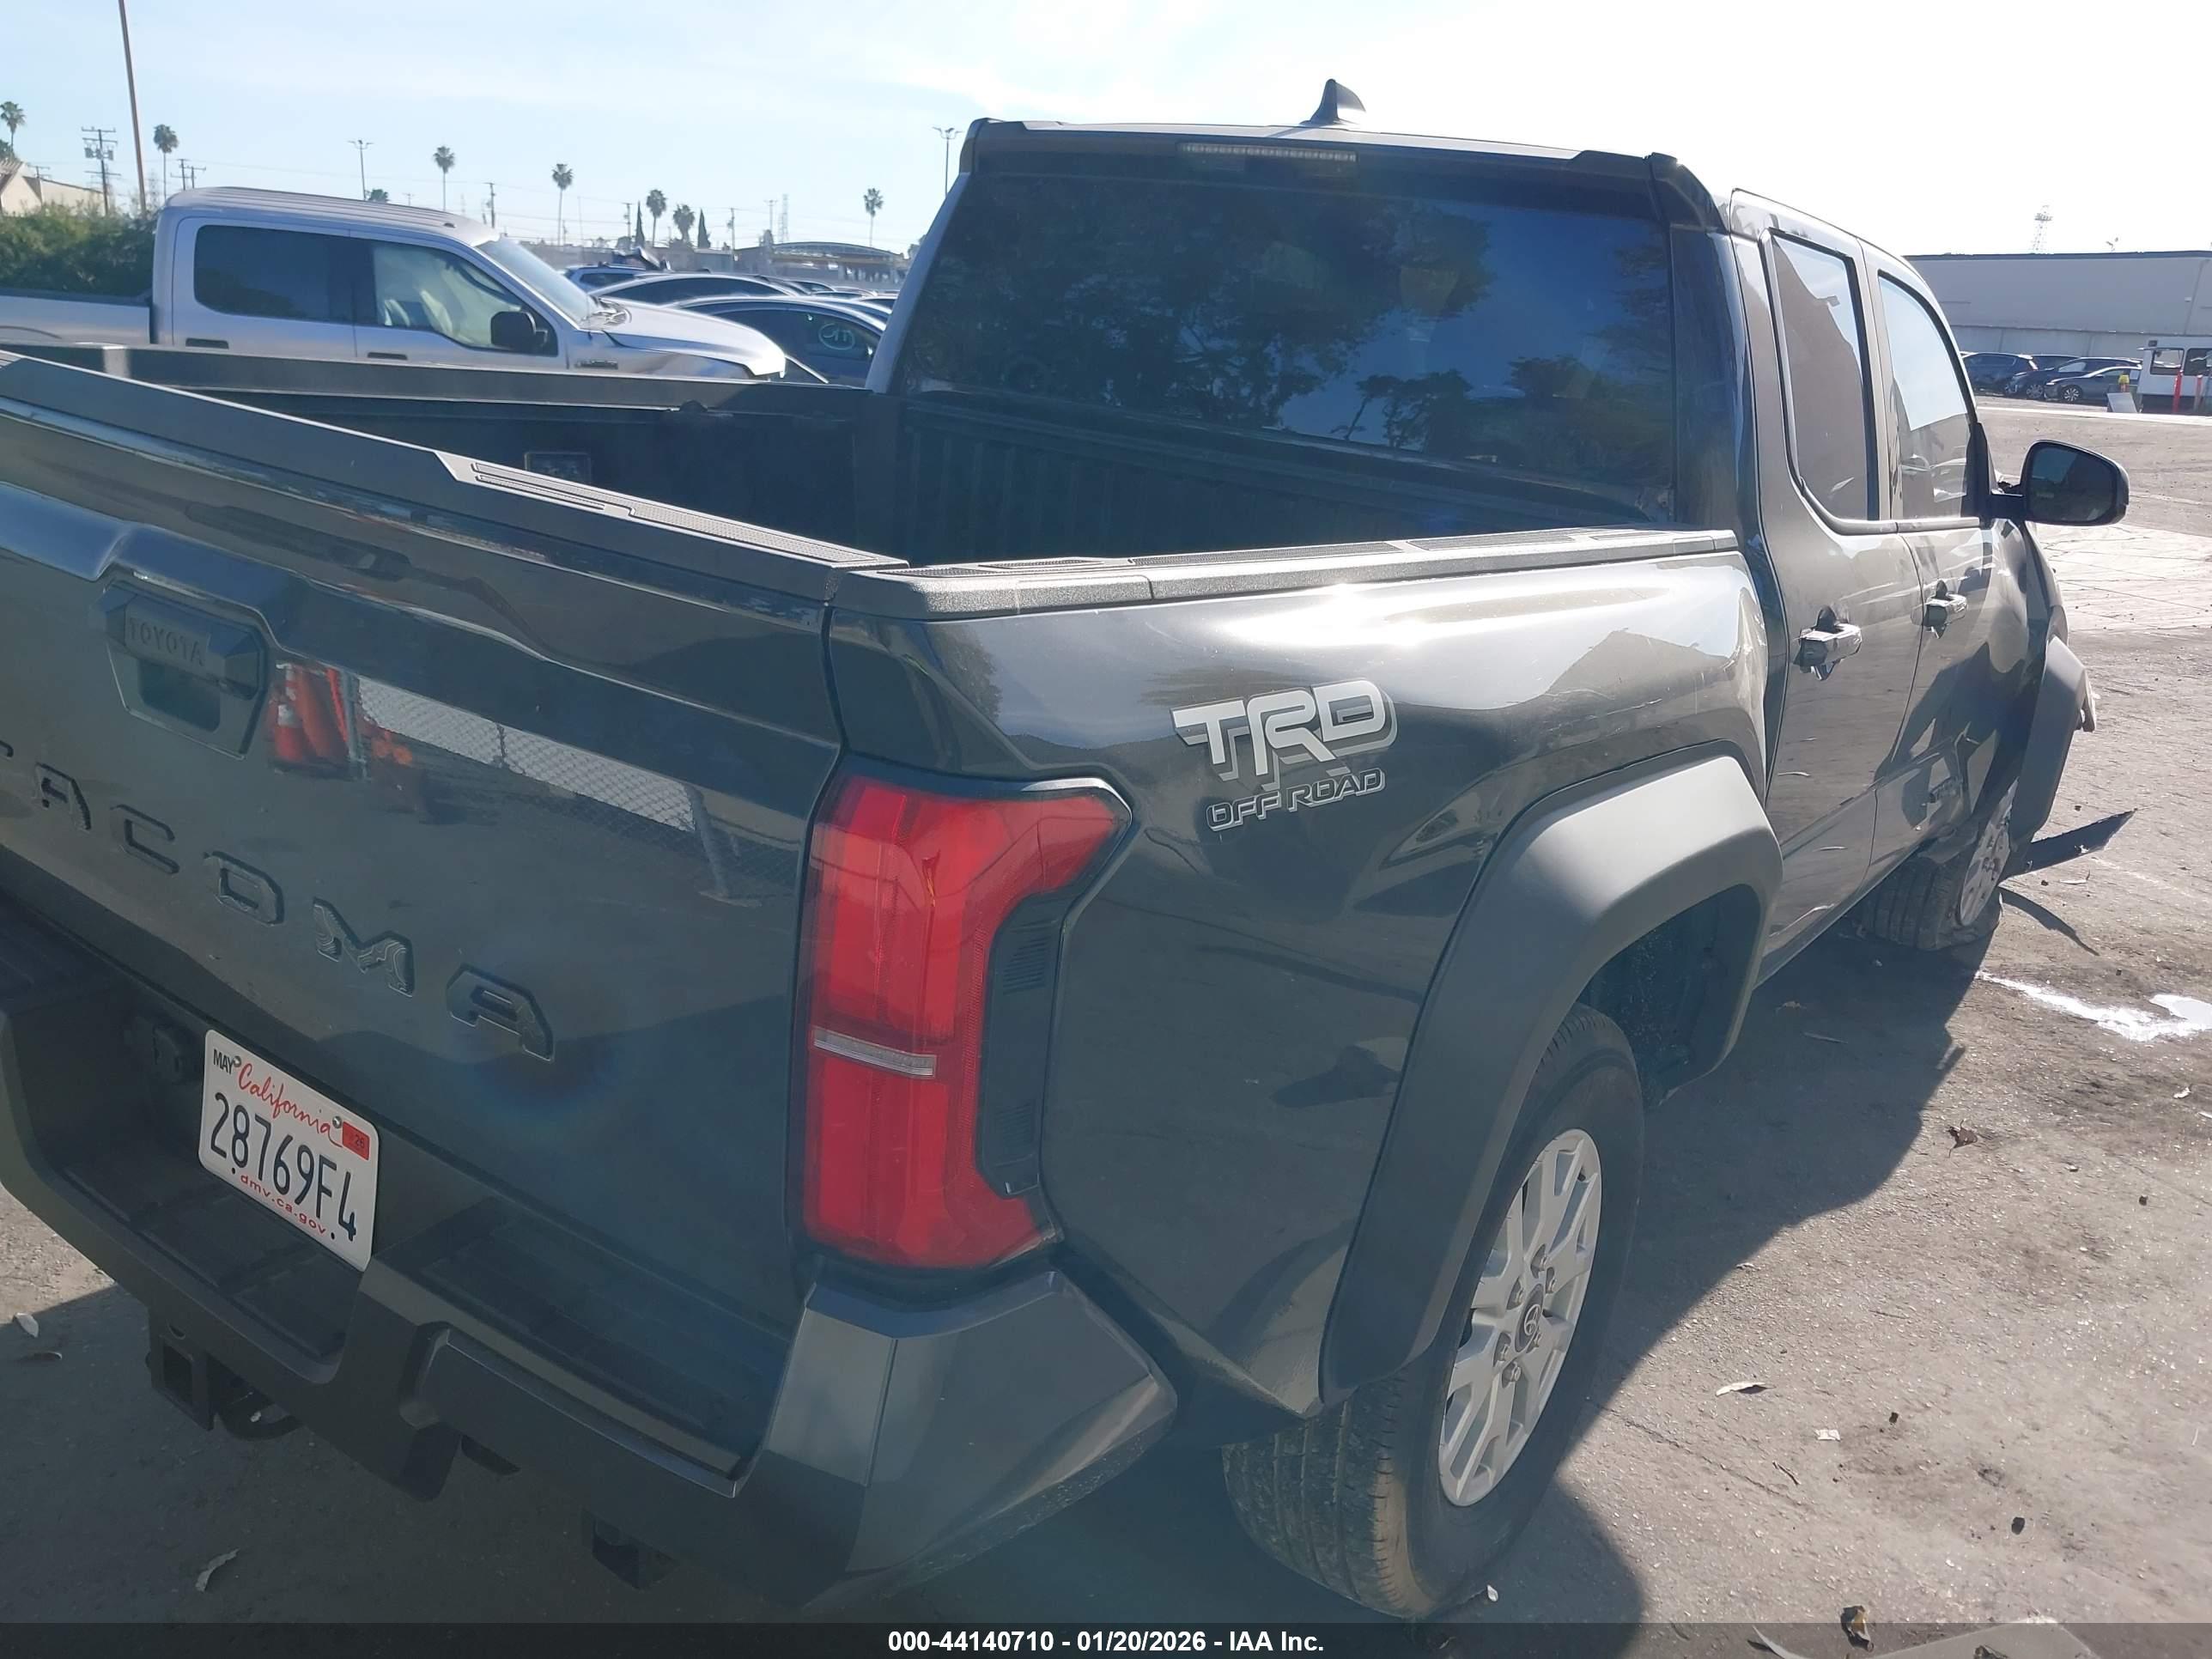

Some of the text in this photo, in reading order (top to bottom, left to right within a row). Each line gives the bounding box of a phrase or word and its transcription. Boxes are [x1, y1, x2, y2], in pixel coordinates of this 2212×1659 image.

[129, 617, 206, 667] TOYOTA
[1170, 679, 1395, 785] TRD
[1206, 768, 1386, 831] OFF ROAD
[0, 739, 555, 1061] ACOMA
[213, 1048, 234, 1074] MAY
[238, 1062, 343, 1148] California
[210, 1091, 357, 1242] 28769F4
[240, 1173, 327, 1235] dmv.ca.gov
